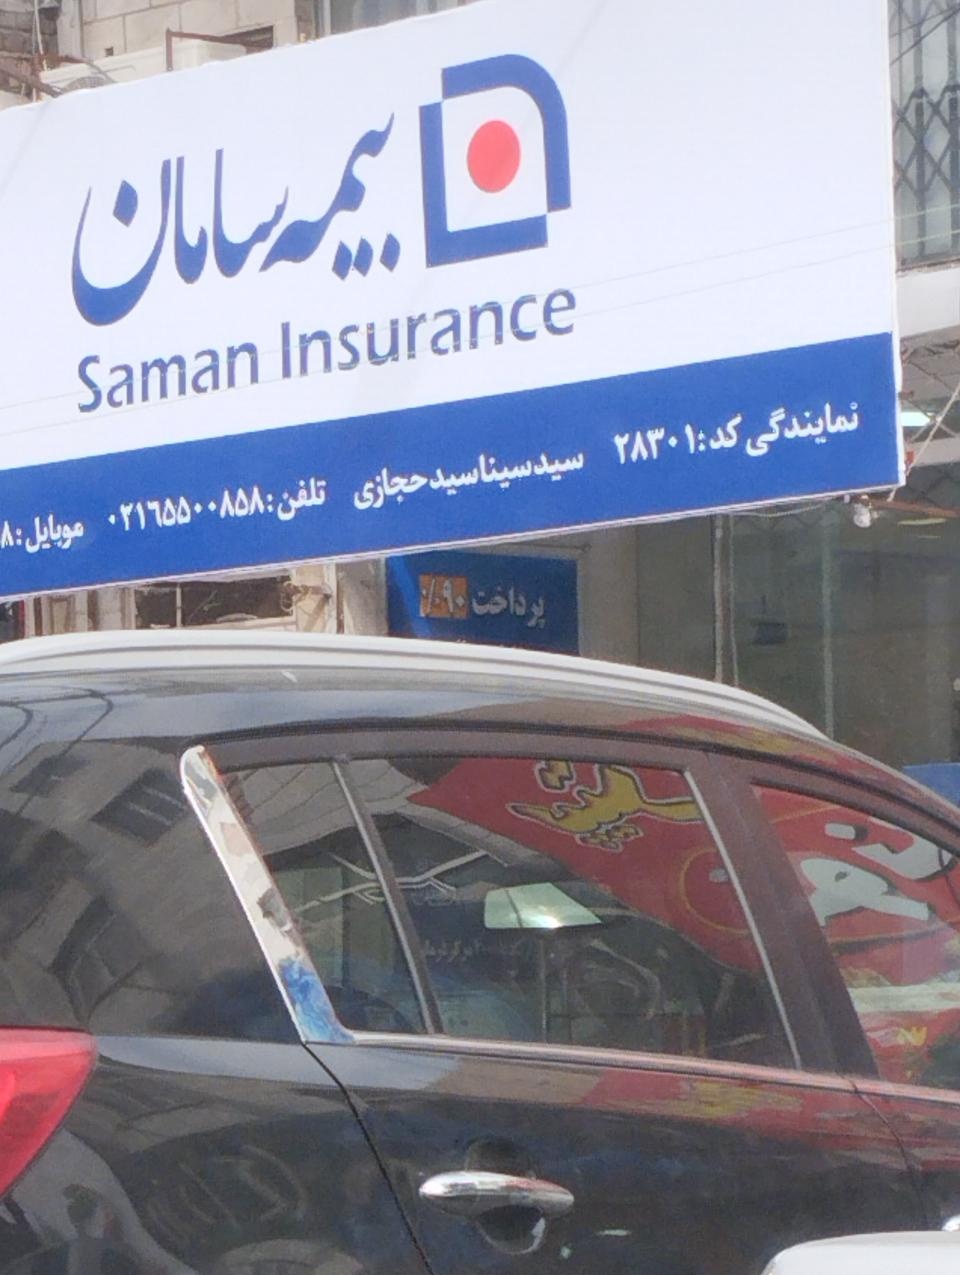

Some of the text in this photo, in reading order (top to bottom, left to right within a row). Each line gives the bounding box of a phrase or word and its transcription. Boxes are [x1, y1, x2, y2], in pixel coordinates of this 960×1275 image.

[71, 112, 402, 326] بیمه سامان
[77, 287, 577, 413] Saman Insurance
[746, 402, 859, 457] نمایندگی
